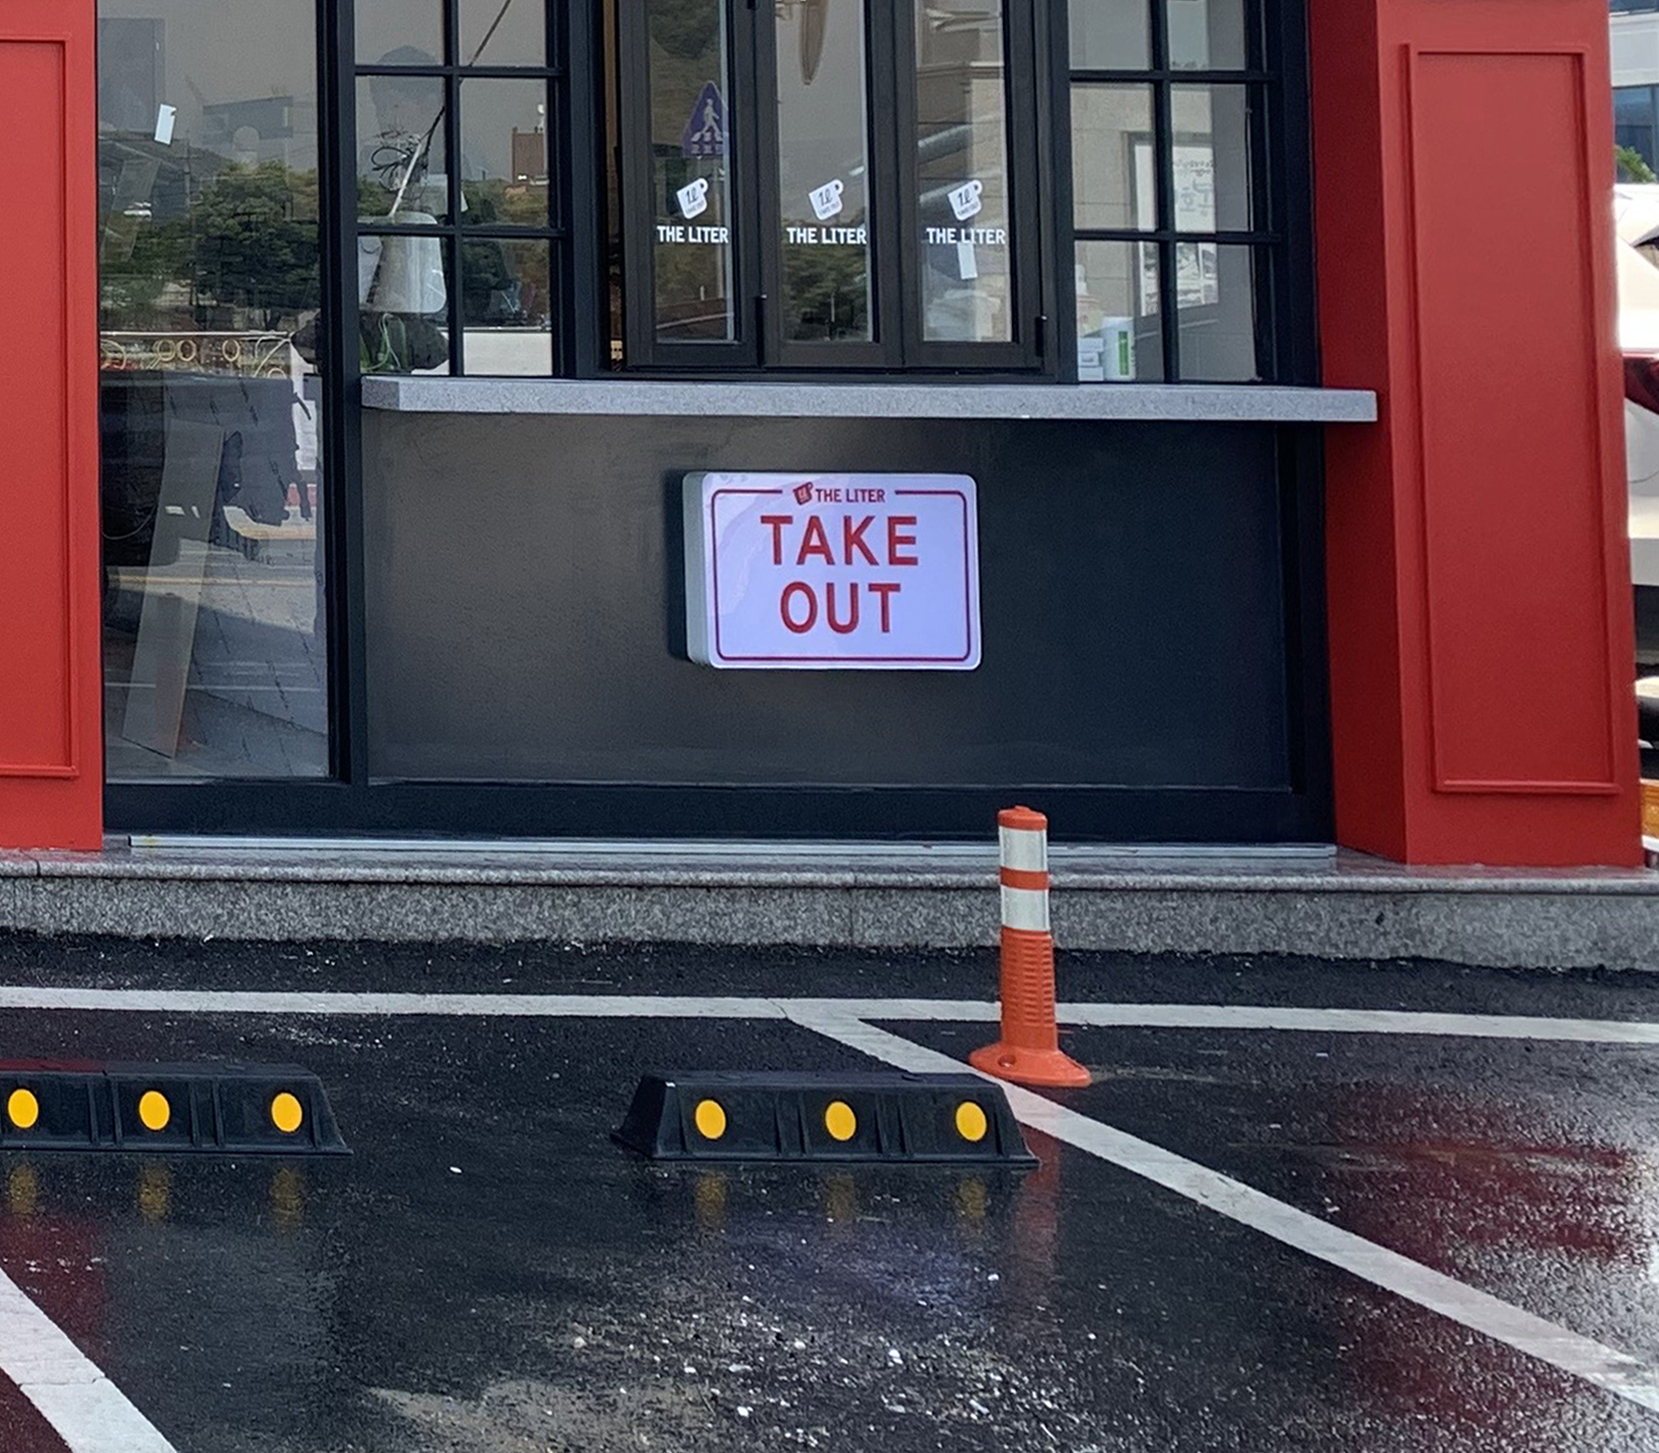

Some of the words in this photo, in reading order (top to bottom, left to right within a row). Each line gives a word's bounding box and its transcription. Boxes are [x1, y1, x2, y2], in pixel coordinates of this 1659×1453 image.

[657, 225, 685, 243] THE
[688, 226, 729, 244] LITER
[786, 227, 818, 244] THE
[822, 227, 868, 244] LITER
[926, 227, 957, 244] THE
[961, 227, 1006, 245] LITER
[815, 488, 842, 503] THE
[845, 488, 886, 503] LITER
[760, 515, 919, 566] TAKE
[779, 581, 901, 634] OUT
